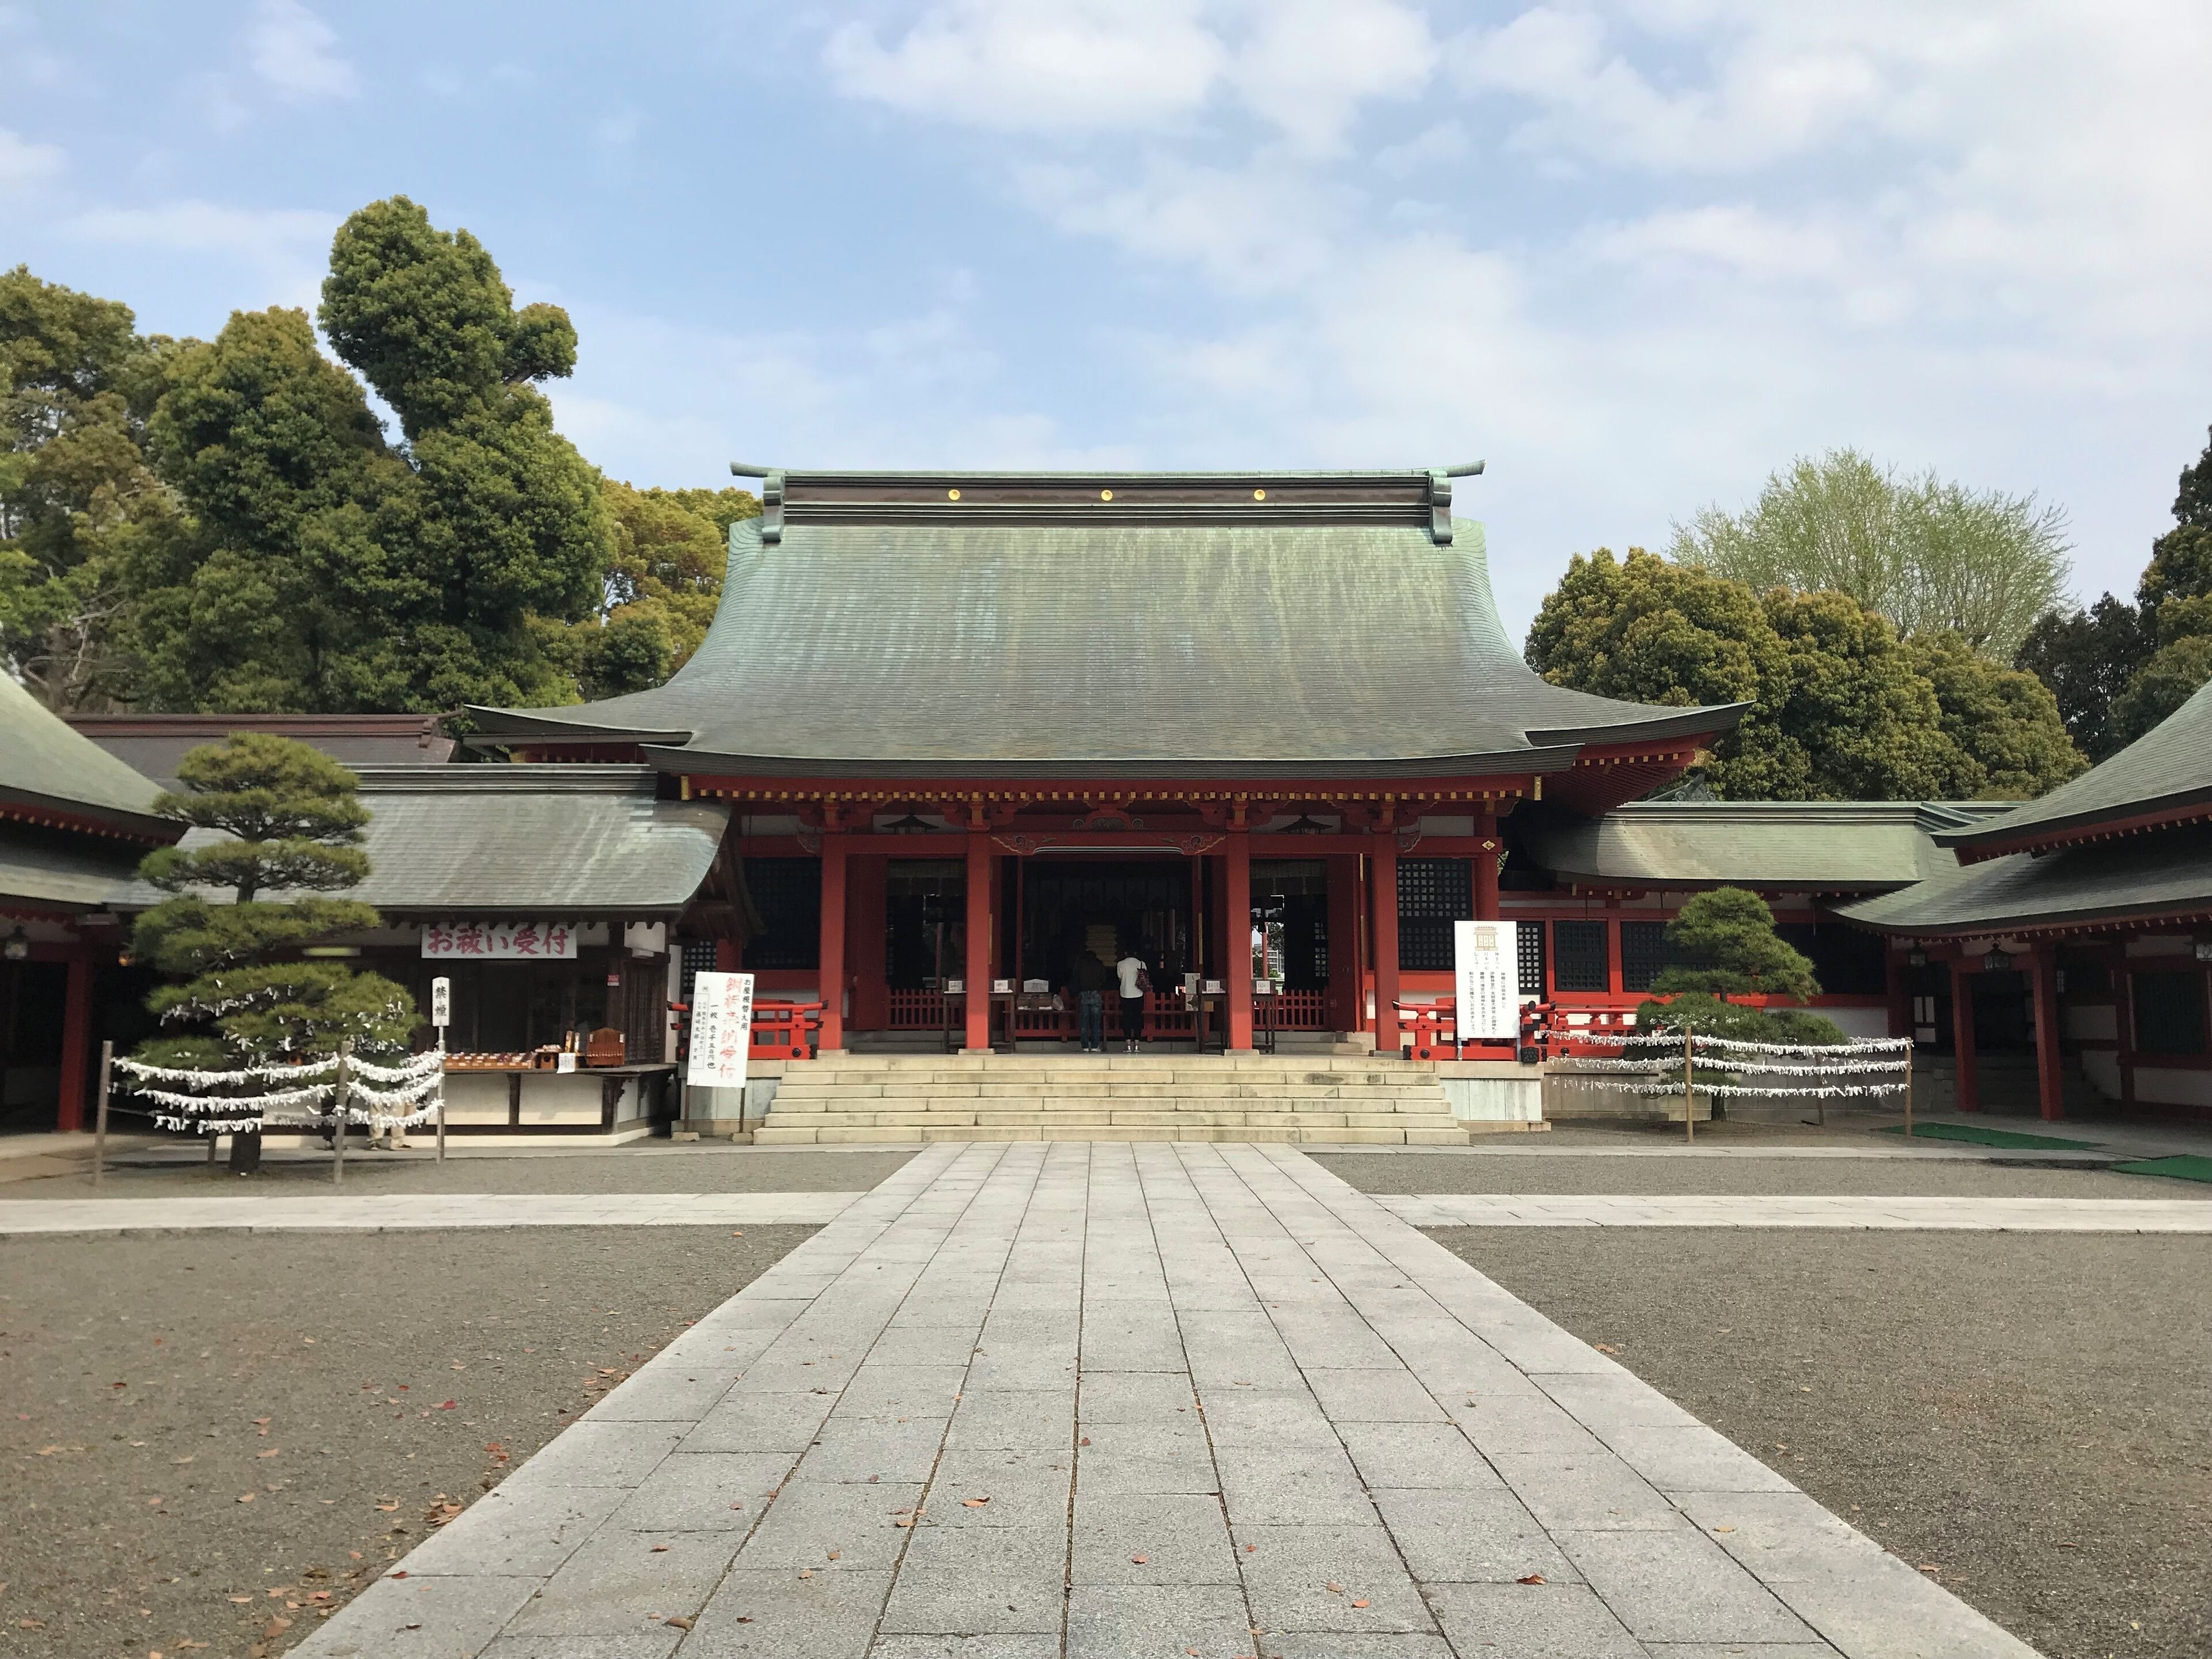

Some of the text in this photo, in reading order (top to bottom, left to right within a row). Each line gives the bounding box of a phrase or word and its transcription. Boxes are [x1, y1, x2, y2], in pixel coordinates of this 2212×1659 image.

[428, 928, 569, 954] お祓い受付
[435, 986, 446, 1016] 禁煙
